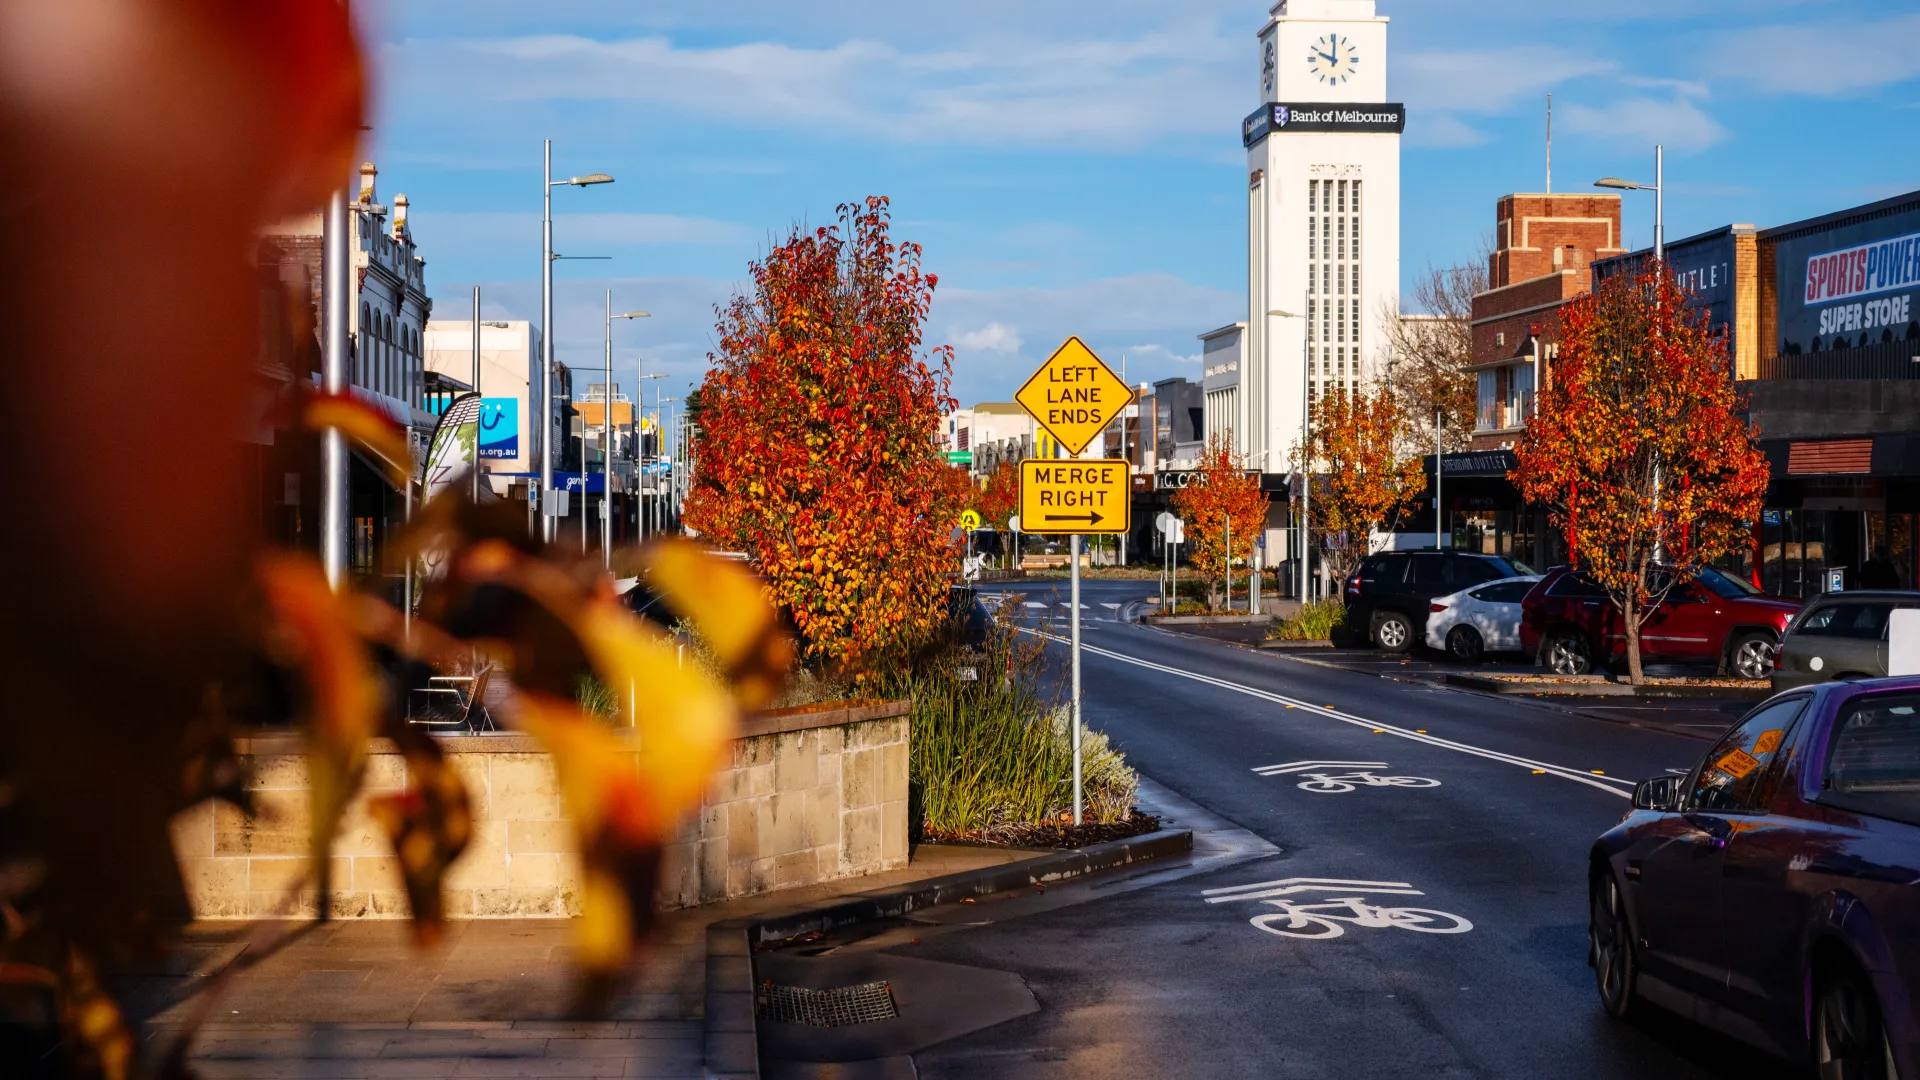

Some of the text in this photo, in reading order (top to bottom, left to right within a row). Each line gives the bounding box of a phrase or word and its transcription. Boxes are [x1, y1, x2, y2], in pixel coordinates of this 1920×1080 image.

[1290, 110, 1398, 123] Bank of Melbourne
[1677, 262, 1728, 295] UTLET
[1819, 294, 1911, 336] SUPER STORE
[1050, 367, 1098, 382] LEFT
[1047, 388, 1102, 403] LANE
[1049, 409, 1102, 424] ENDS
[1474, 455, 1507, 470] OUTLET
[1036, 468, 1113, 484] MERGE
[1041, 490, 1108, 506] RIGHT
[1832, 574, 1841, 584] P
